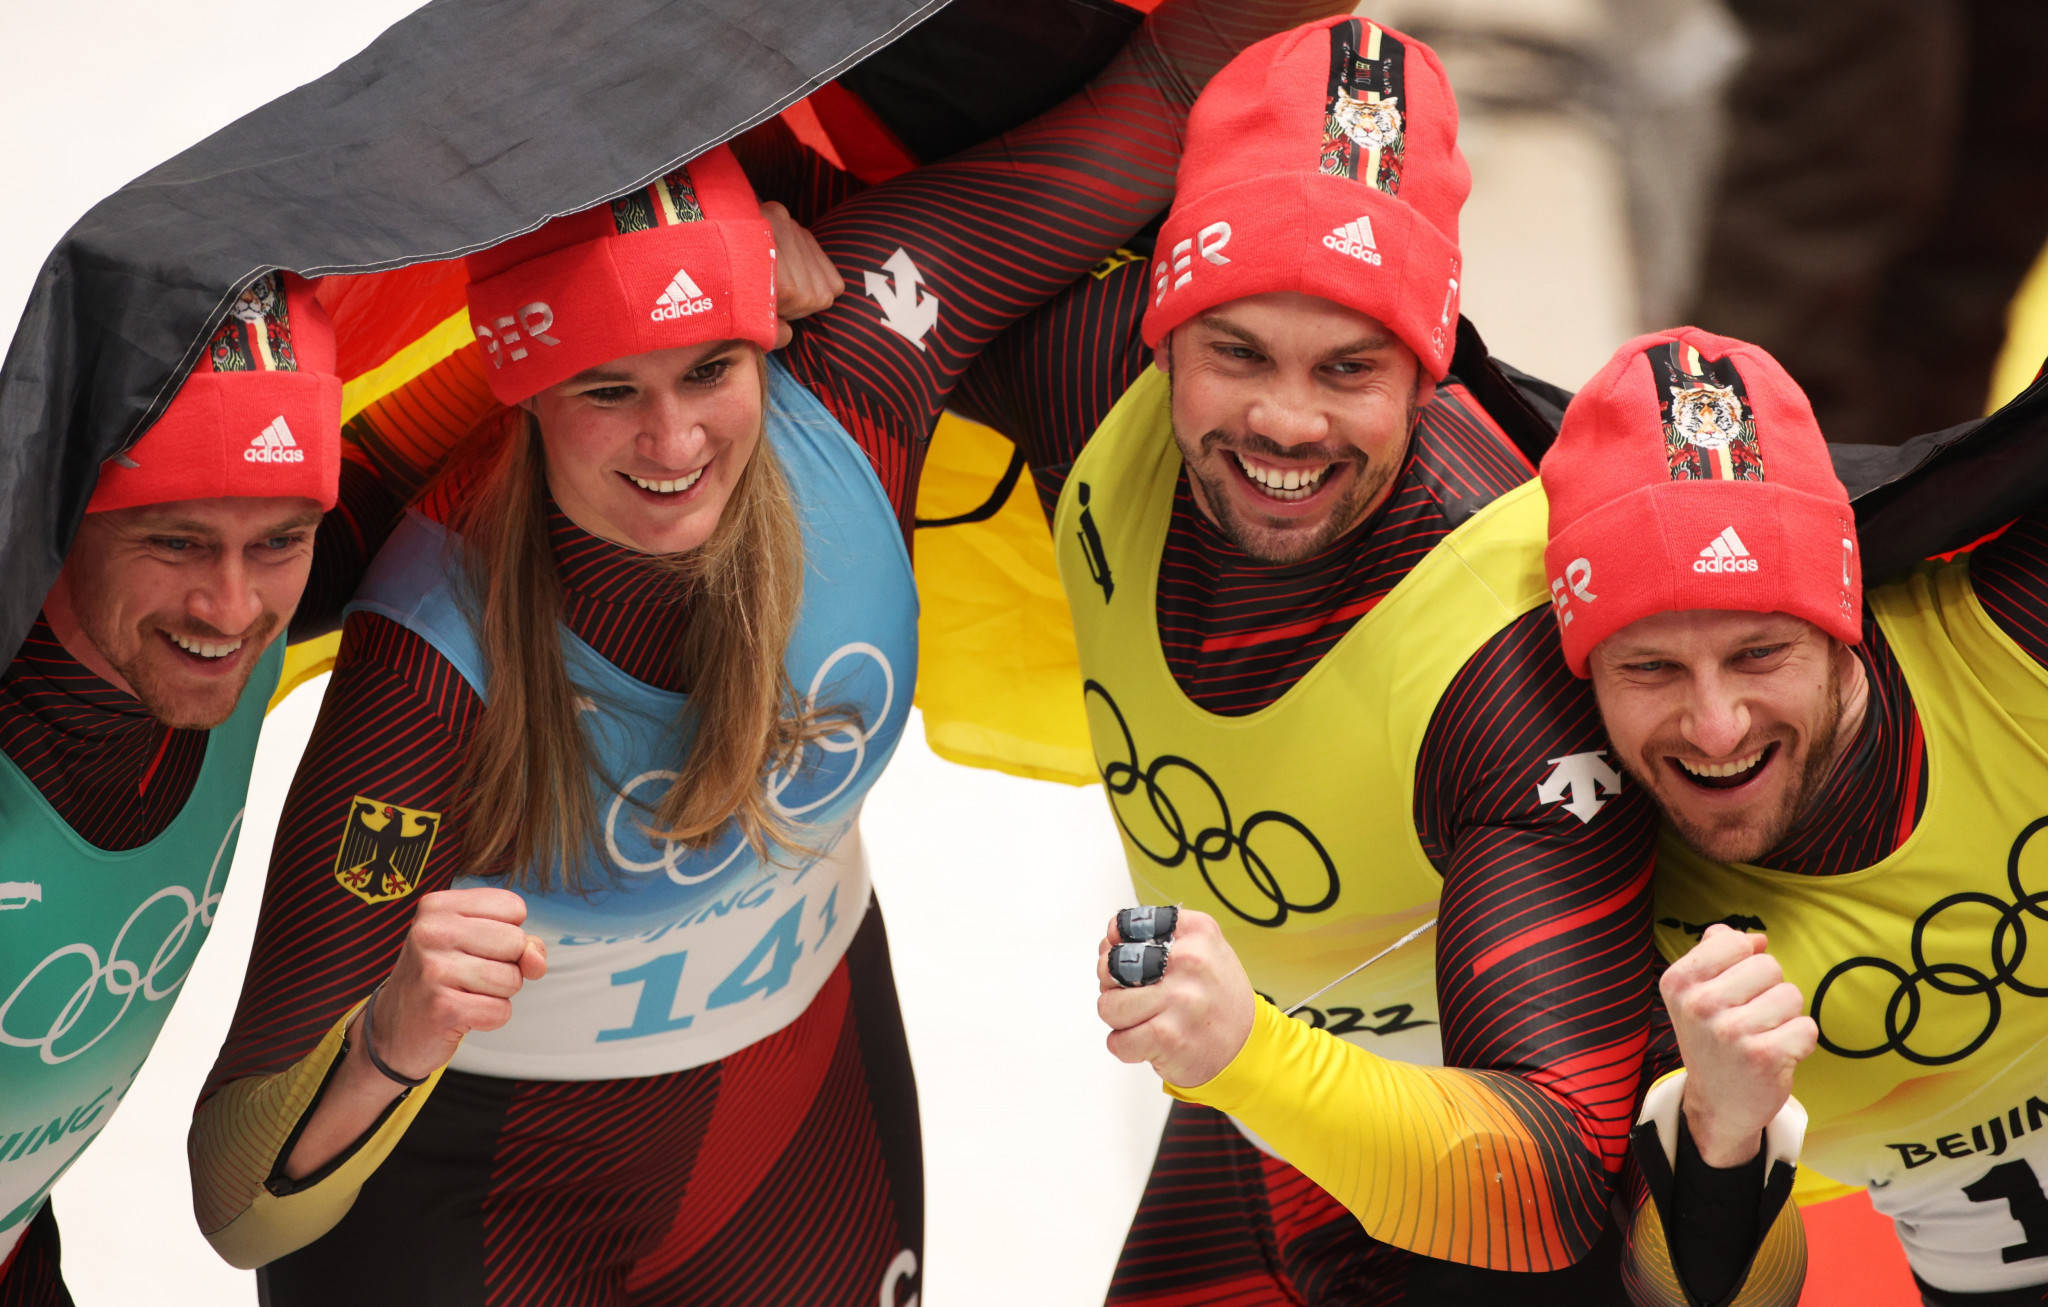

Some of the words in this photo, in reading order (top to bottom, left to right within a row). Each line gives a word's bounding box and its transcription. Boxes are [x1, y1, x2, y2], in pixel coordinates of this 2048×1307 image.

[1322, 234, 1382, 267] adidas
[650, 296, 713, 323] adidas
[243, 448, 305, 463] adidas
[1693, 557, 1759, 573] adidas
[1551, 557, 1598, 633] ER
[595, 895, 807, 1044] 14
[1255, 988, 1439, 1037] 022
[0, 1085, 114, 1164] JING
